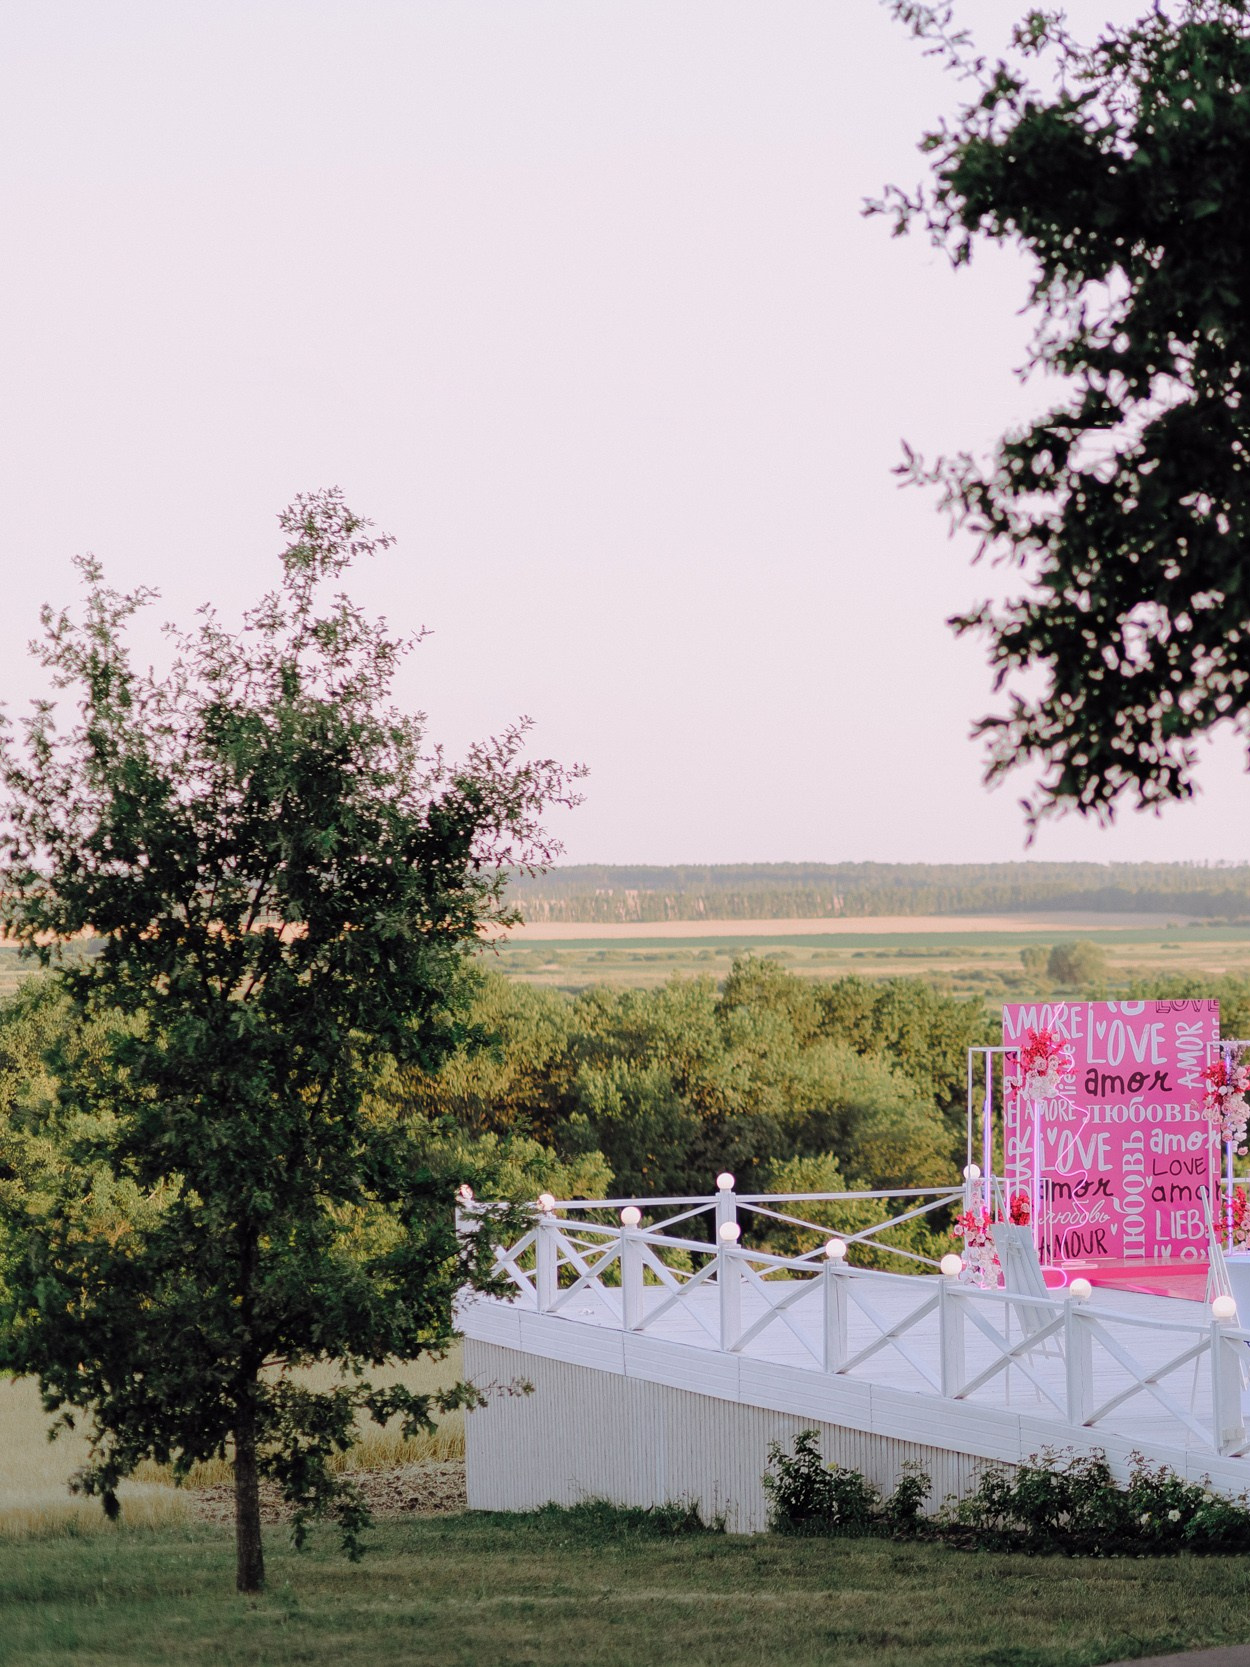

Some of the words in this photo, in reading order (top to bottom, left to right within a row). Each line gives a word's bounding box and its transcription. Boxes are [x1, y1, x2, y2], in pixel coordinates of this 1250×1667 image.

[1087, 1003, 1168, 1067] LOVE
[1175, 1020, 1205, 1090] AMOR
[1084, 1068, 1173, 1098] amor
[1082, 1096, 1201, 1124] любовь
[1039, 1129, 1113, 1173] LOVE
[1152, 1157, 1207, 1176] LOVE
